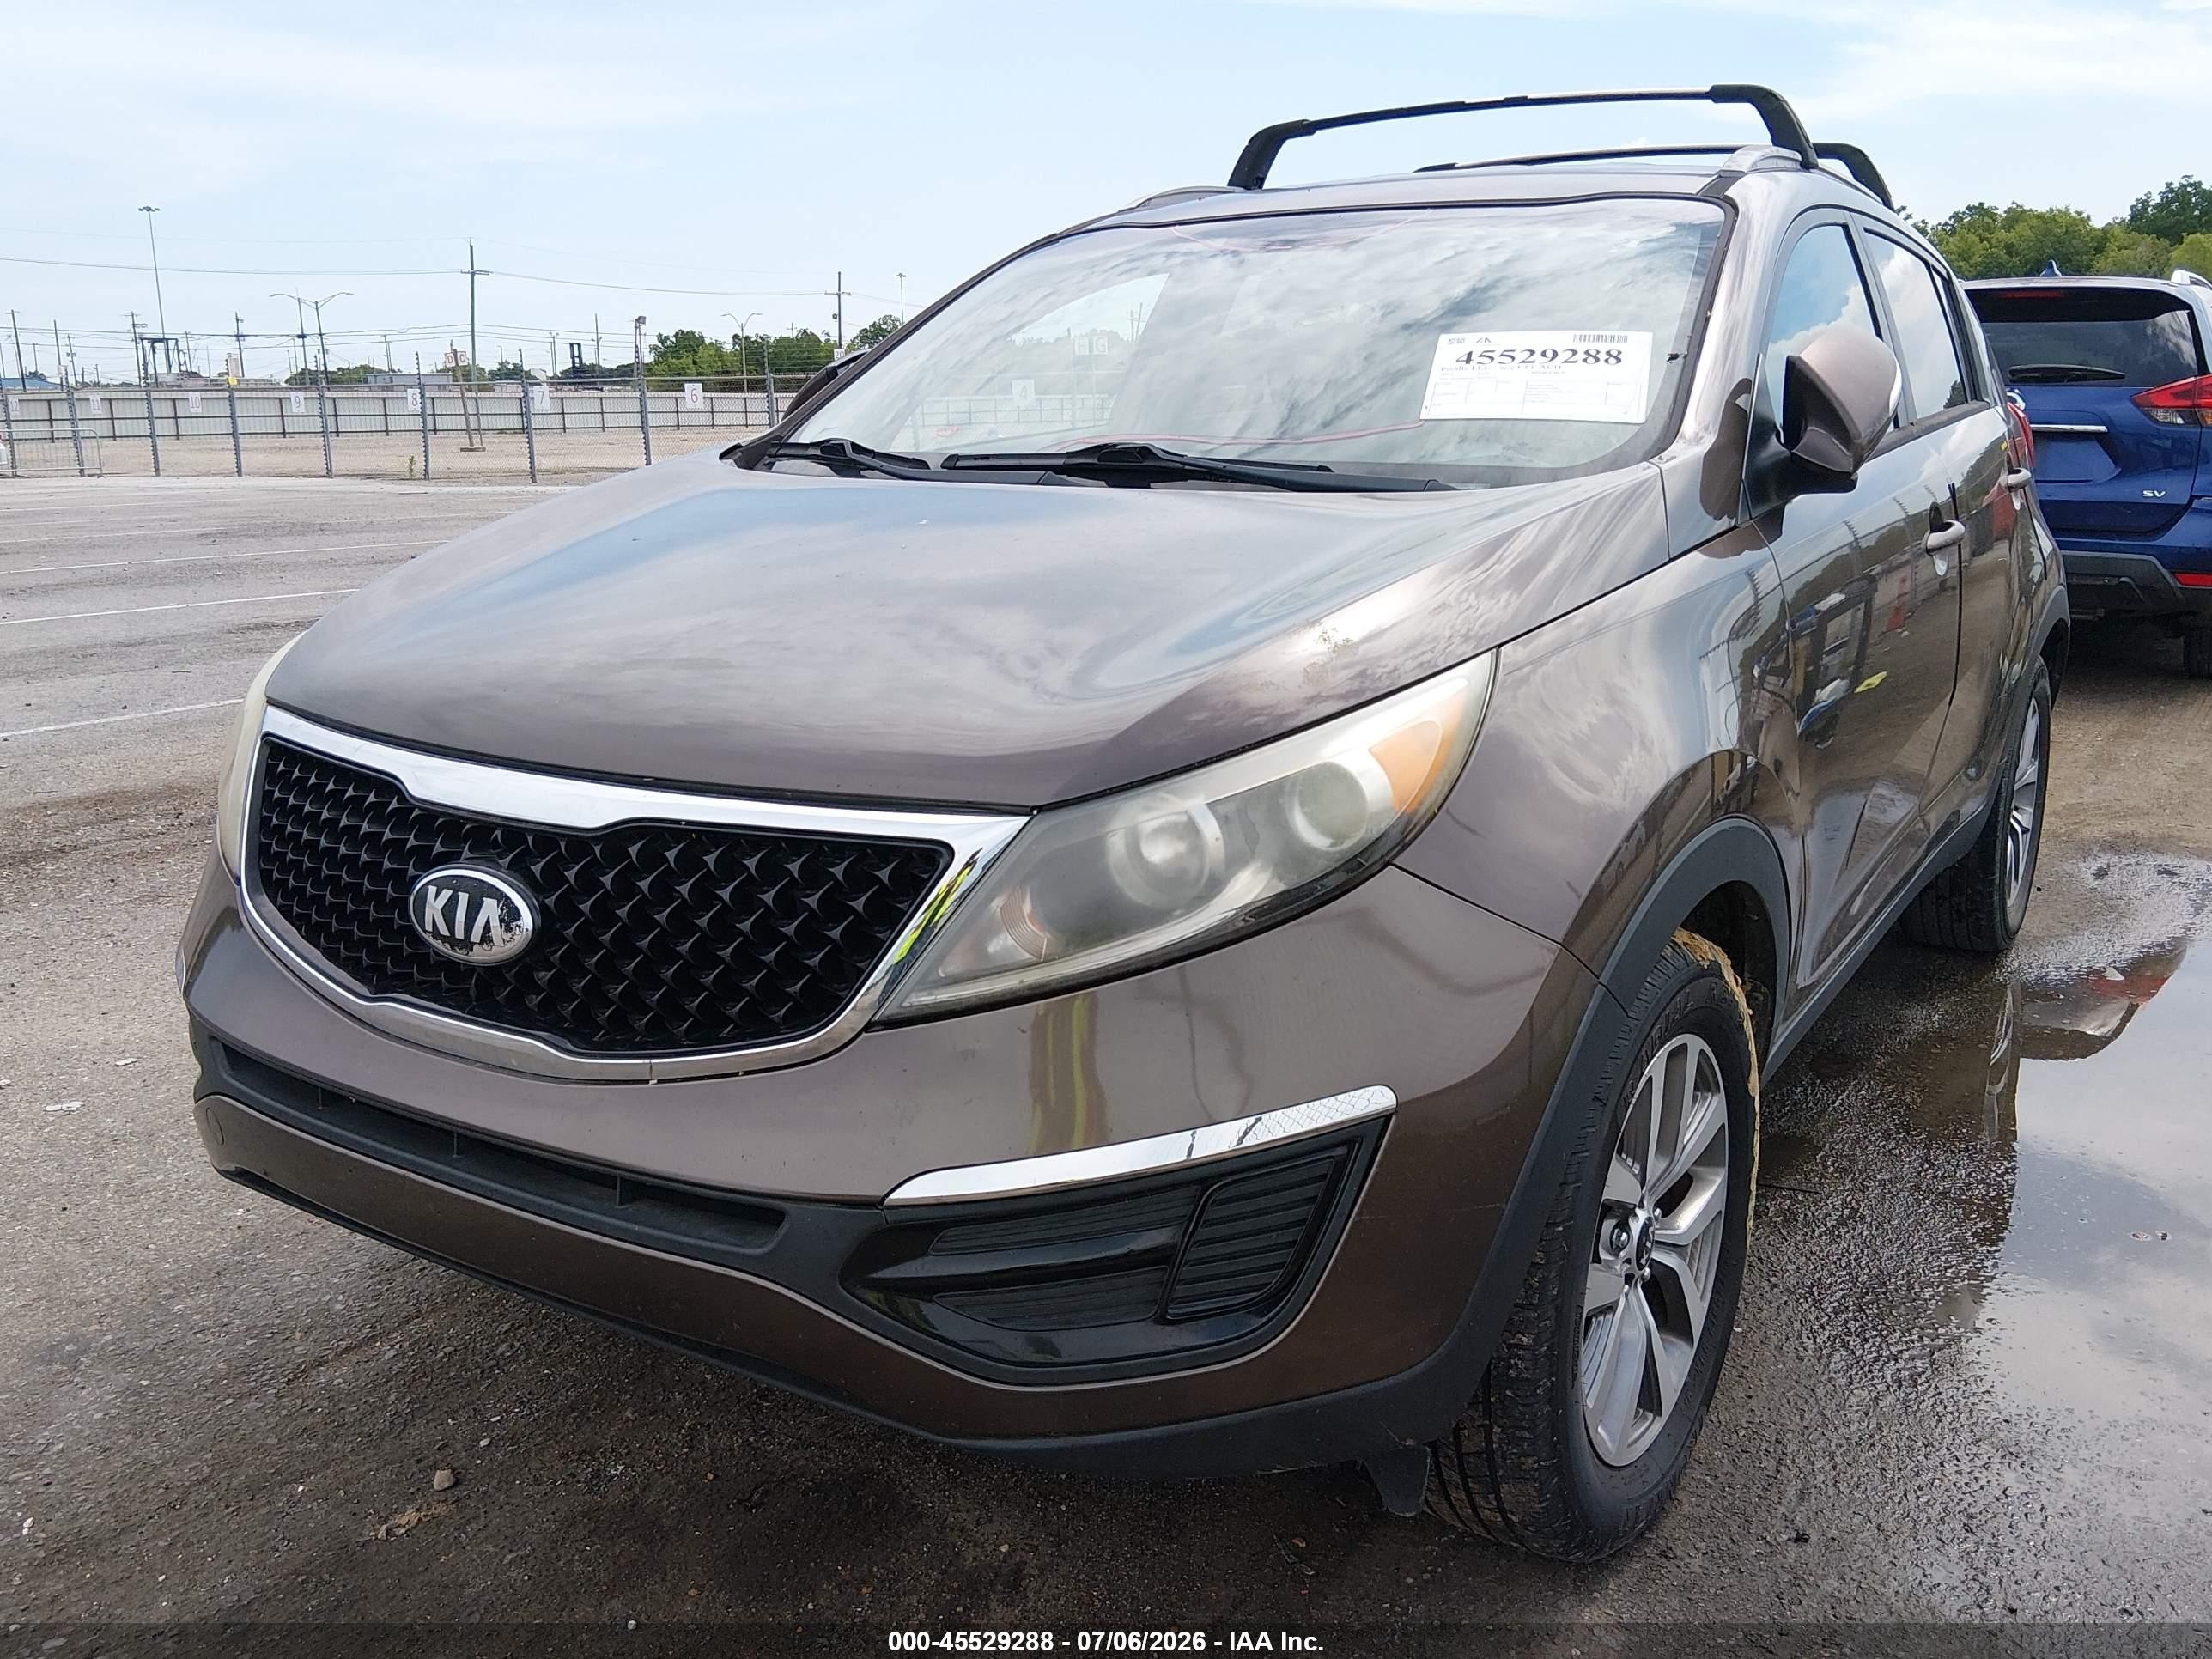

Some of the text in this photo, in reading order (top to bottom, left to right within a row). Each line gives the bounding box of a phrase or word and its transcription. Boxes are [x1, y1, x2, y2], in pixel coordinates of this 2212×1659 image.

[447, 355, 453, 364] D
[459, 354, 466, 363] C
[1455, 349, 1623, 365] 45529288
[191, 396, 200, 409] 10
[295, 395, 301, 408] 9
[411, 392, 417, 406] 8
[538, 391, 544, 404] 7
[690, 388, 698, 404] 6
[424, 884, 507, 947] KIA
